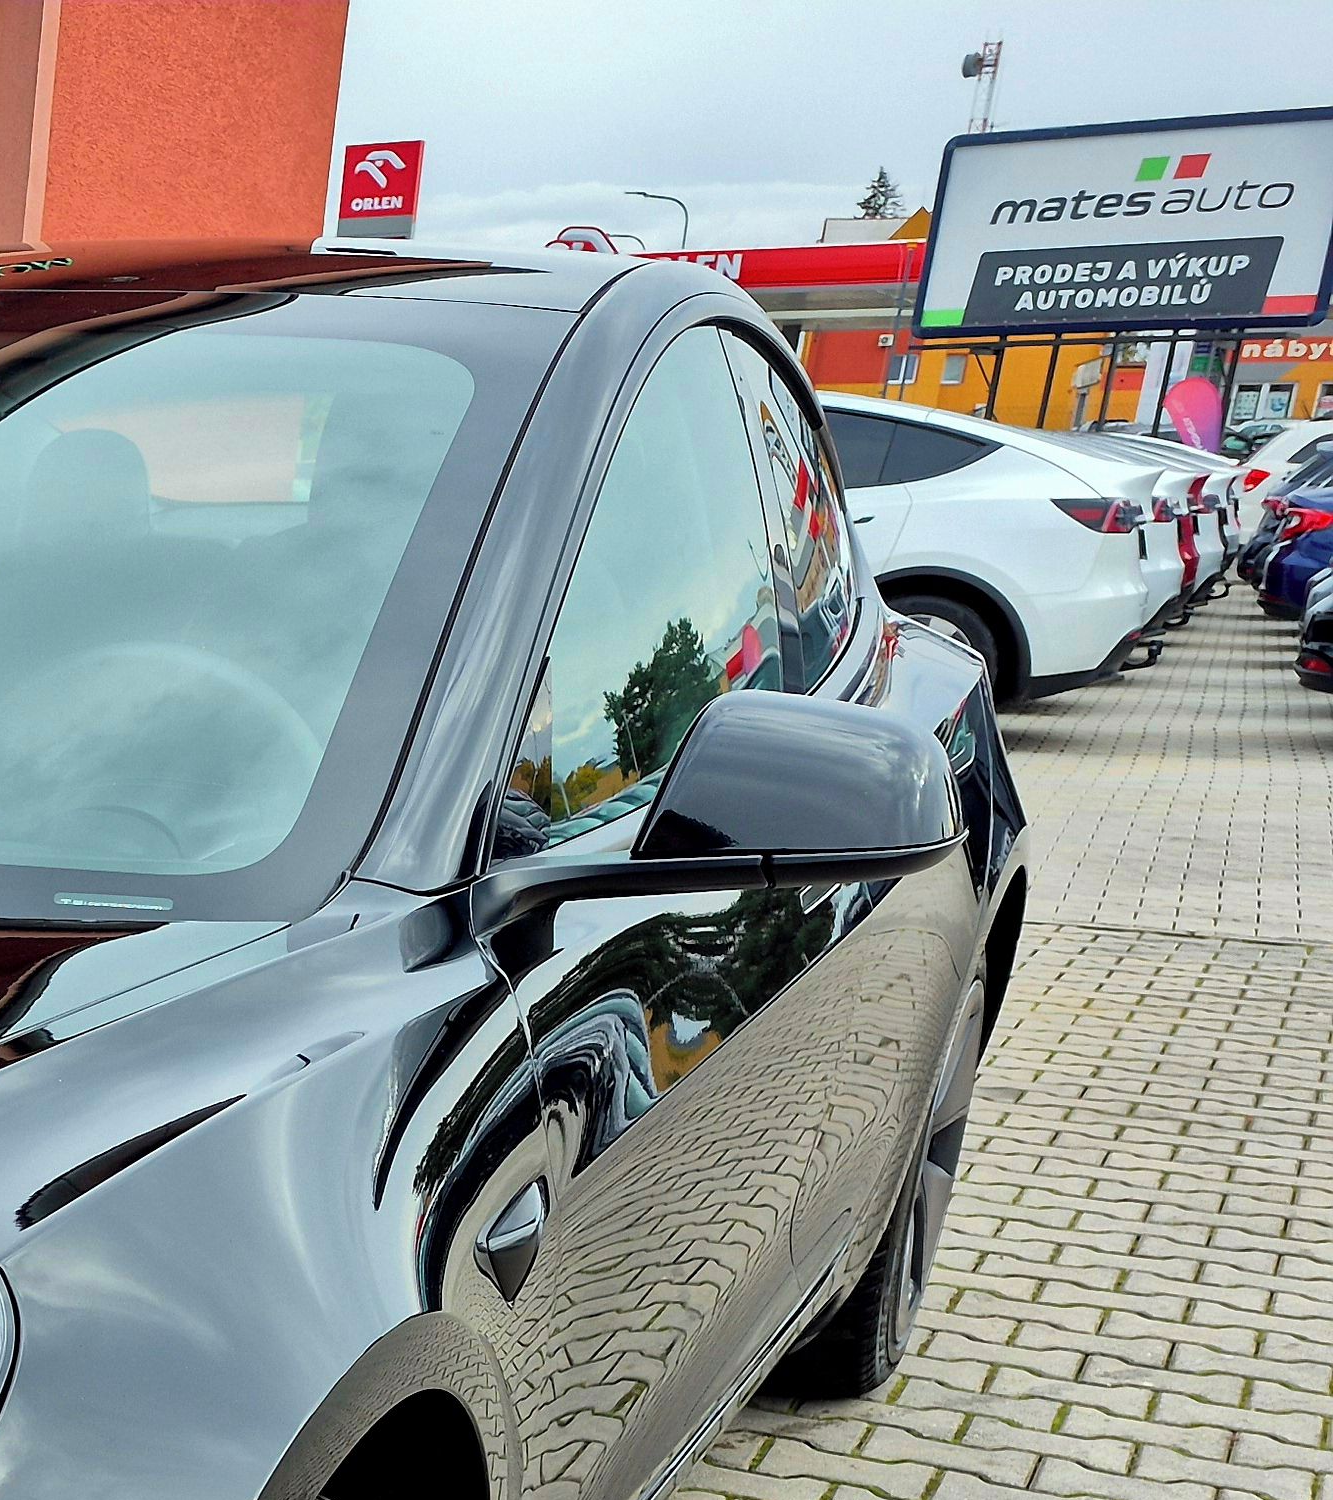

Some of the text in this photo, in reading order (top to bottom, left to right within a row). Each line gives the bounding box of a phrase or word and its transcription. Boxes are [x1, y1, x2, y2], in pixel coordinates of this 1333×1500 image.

[350, 195, 404, 212] ORLEN
[989, 180, 1295, 226] mates auto
[994, 251, 1251, 287] PRODEJ A VÝKUP
[1014, 278, 1213, 313] AUTOMOBILŮ
